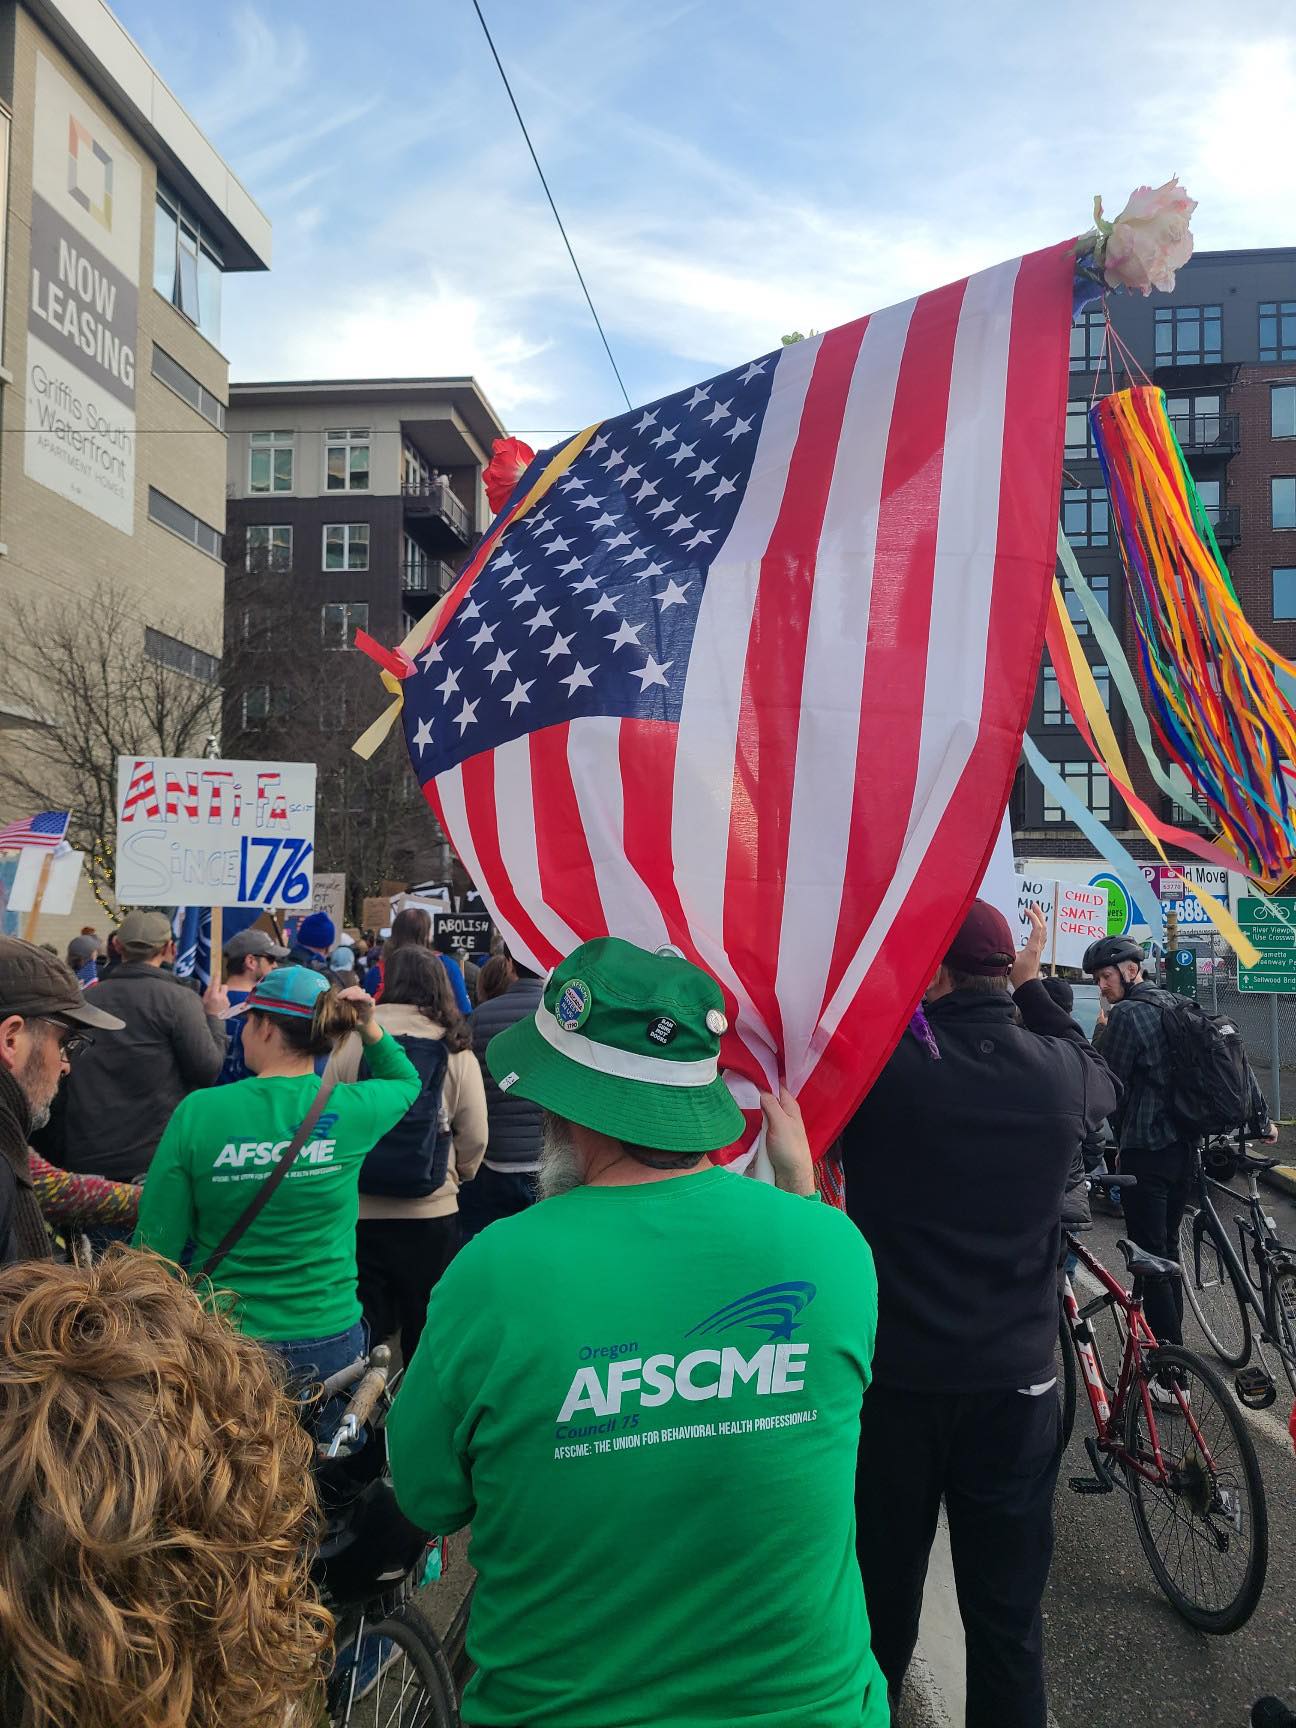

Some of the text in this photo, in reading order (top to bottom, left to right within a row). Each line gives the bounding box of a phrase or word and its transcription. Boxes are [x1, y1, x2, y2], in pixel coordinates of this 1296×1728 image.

[59, 237, 117, 322] NOW
[31, 268, 135, 389] LEASING
[31, 365, 133, 456] Griffis South
[37, 398, 126, 482] Waterfront
[236, 835, 314, 904] 1776
[1022, 881, 1043, 894] NO
[1065, 890, 1104, 906] CHILD
[1060, 906, 1100, 920] SNAT-
[438, 919, 489, 934] ABOLISH
[1060, 922, 1106, 939] CHERS
[1252, 926, 1268, 934] River
[450, 936, 475, 948] ICE
[1181, 953, 1189, 963] P
[1253, 975, 1281, 984] Sellwood
[657, 1023, 672, 1034] GUNS
[661, 1018, 674, 1028] BAN
[649, 1031, 668, 1044] BOOKS
[655, 1028, 668, 1037] NOT
[213, 1139, 337, 1167] AFSCME
[578, 1340, 639, 1361] Oregon
[555, 1343, 810, 1423] AFSCME
[554, 1409, 818, 1460] AFSCME: THE UNION FOR BEHAVIORAL HEALTH PROFESSIONALS
[555, 1413, 640, 1441] Council 75
